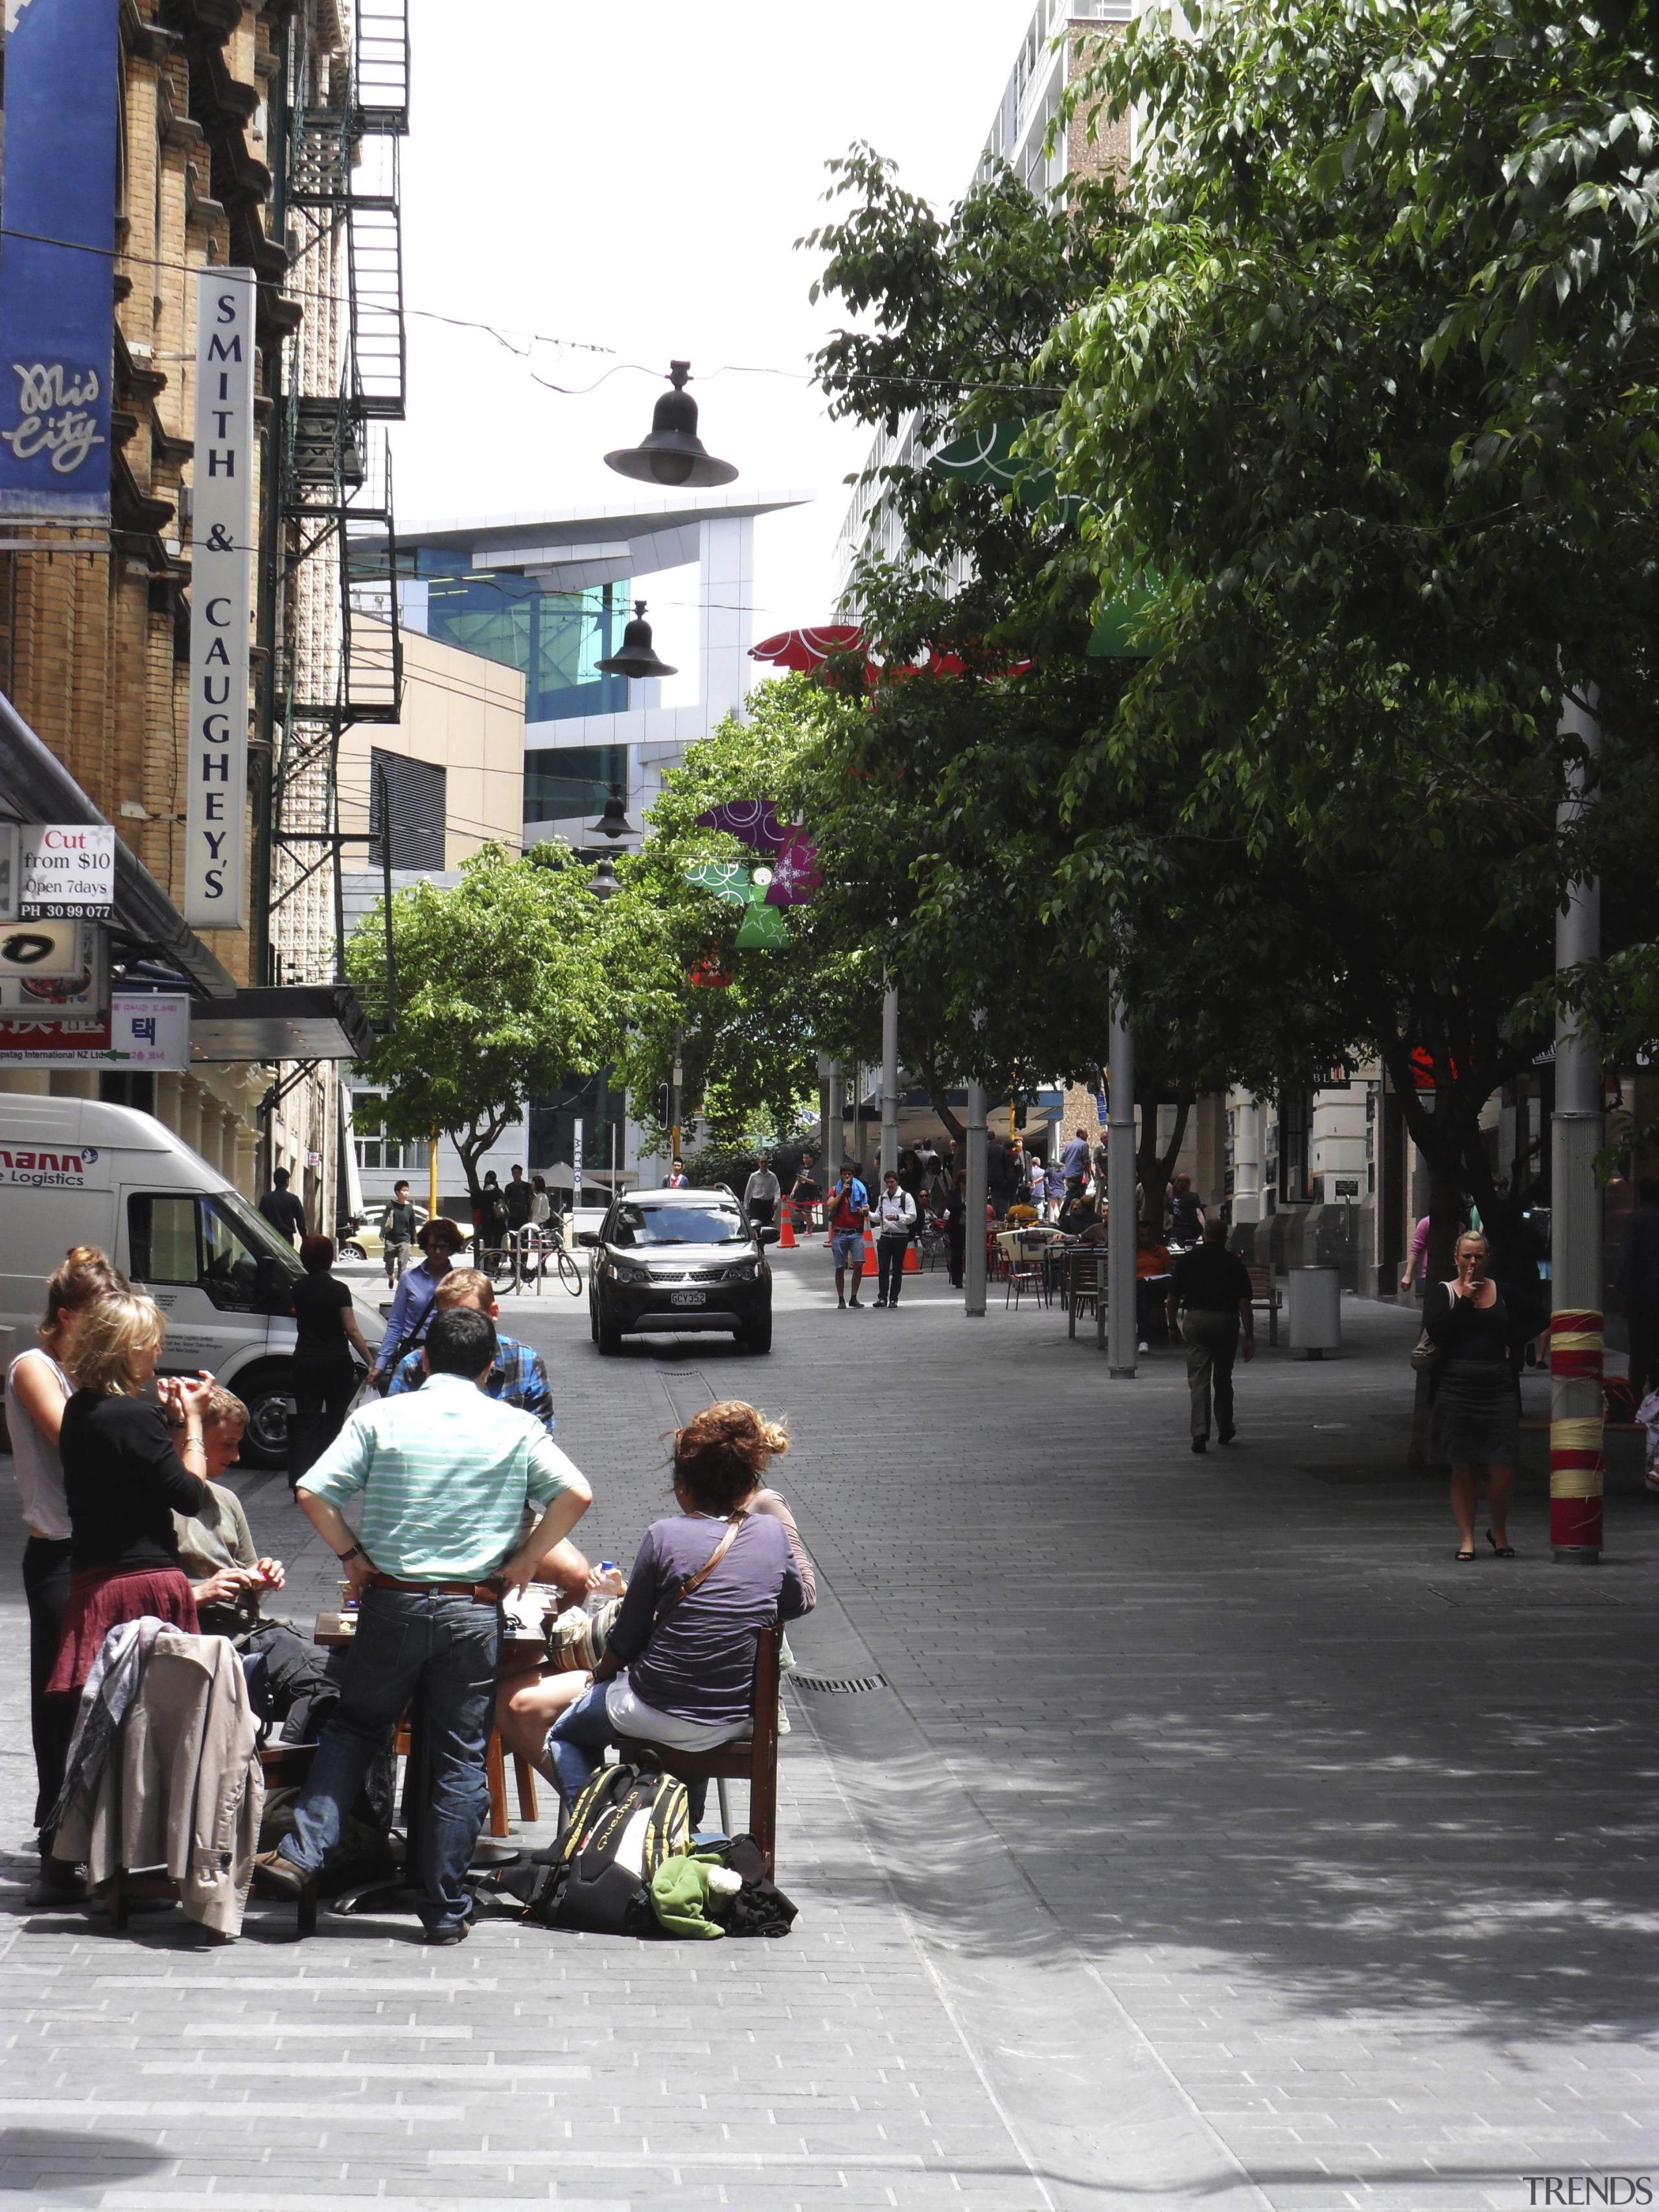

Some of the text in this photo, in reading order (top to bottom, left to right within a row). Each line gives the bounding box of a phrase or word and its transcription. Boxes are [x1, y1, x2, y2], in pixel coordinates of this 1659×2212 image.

[12, 364, 99, 415] Mid
[3, 412, 104, 472] City
[202, 295, 242, 899] SMITH & CAUGHEY'S
[45, 830, 86, 848] Cut
[25, 852, 110, 870] from $10
[26, 879, 107, 896] Open 7days
[21, 905, 110, 917] PH 30 99 077
[132, 1018, 156, 1046] 택
[11, 1170, 84, 1186] Logistics
[672, 1294, 704, 1302] GCY352
[597, 1791, 639, 1851] Quechua
